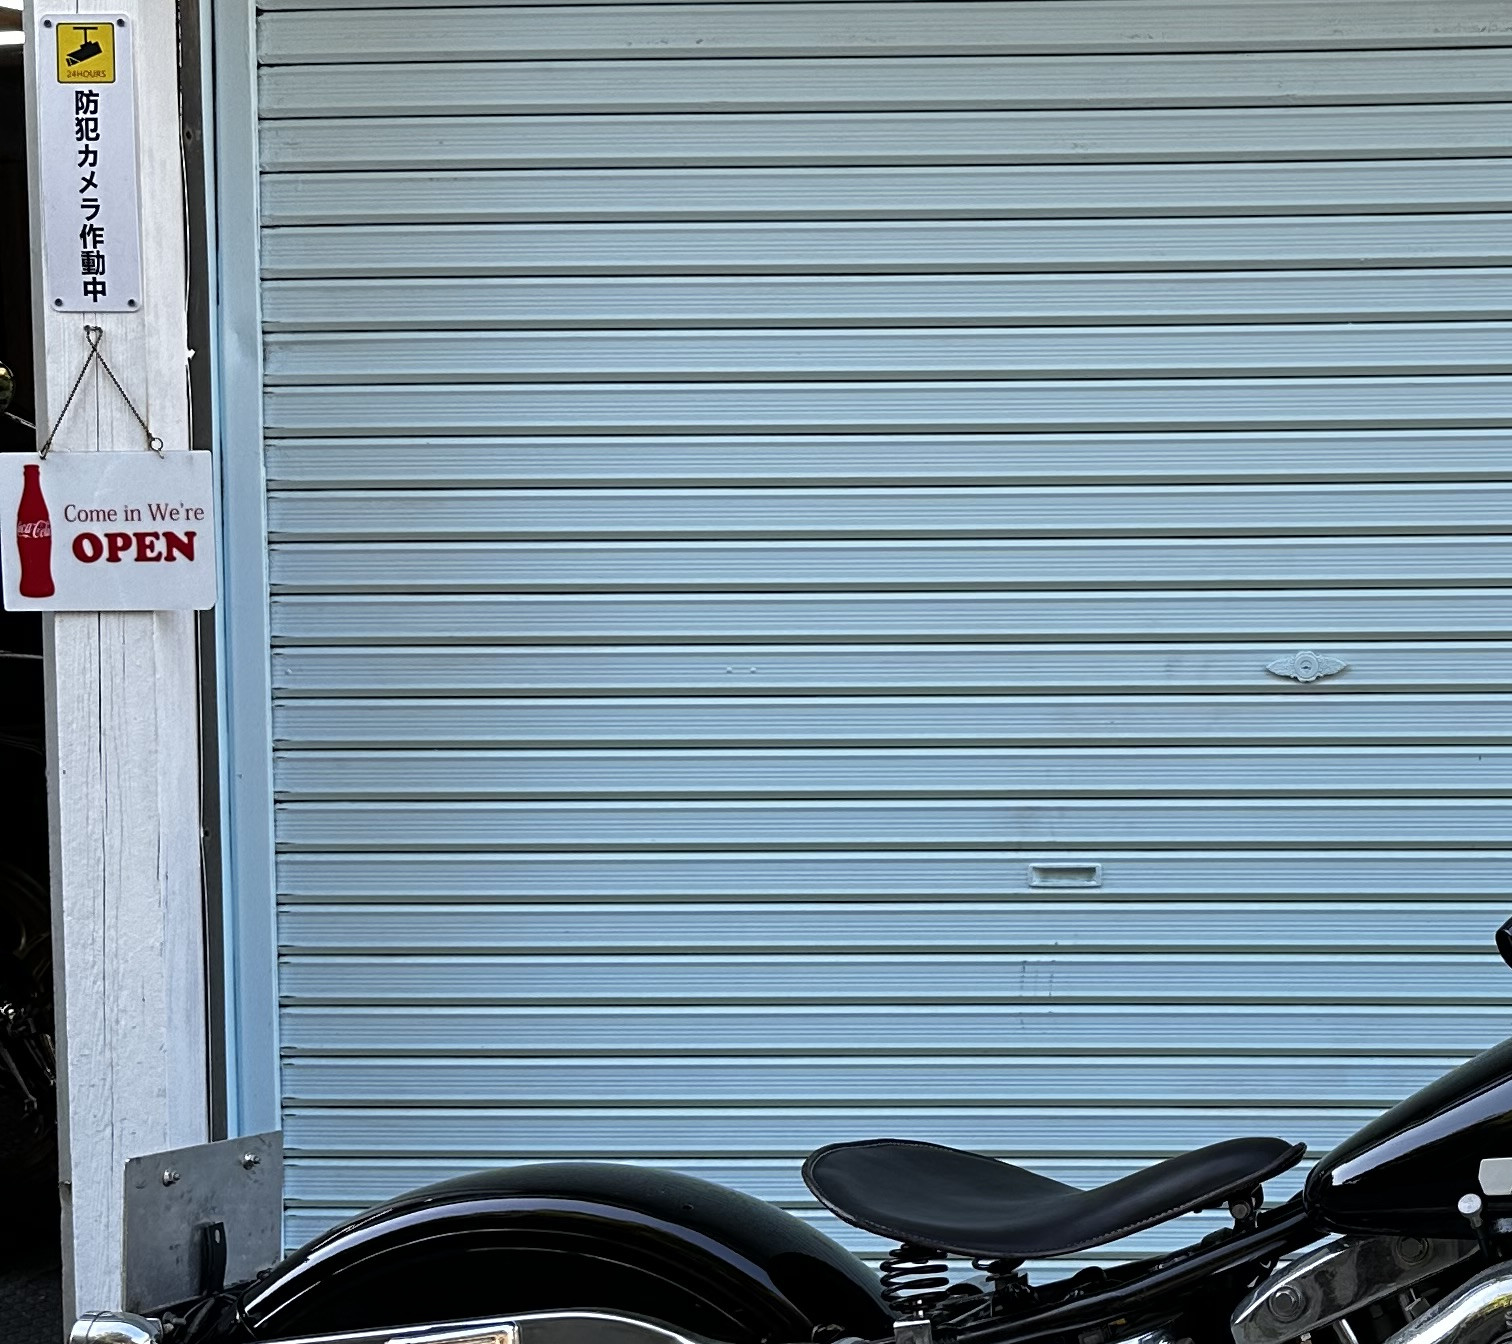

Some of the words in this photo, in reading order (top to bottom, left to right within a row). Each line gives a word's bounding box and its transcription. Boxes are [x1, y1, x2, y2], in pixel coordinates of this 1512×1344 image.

[74, 89, 107, 303] 防犯カメラ作動中
[64, 504, 117, 522] Come
[124, 505, 141, 521] in
[148, 501, 205, 522] We're
[72, 531, 197, 563] OPEN
